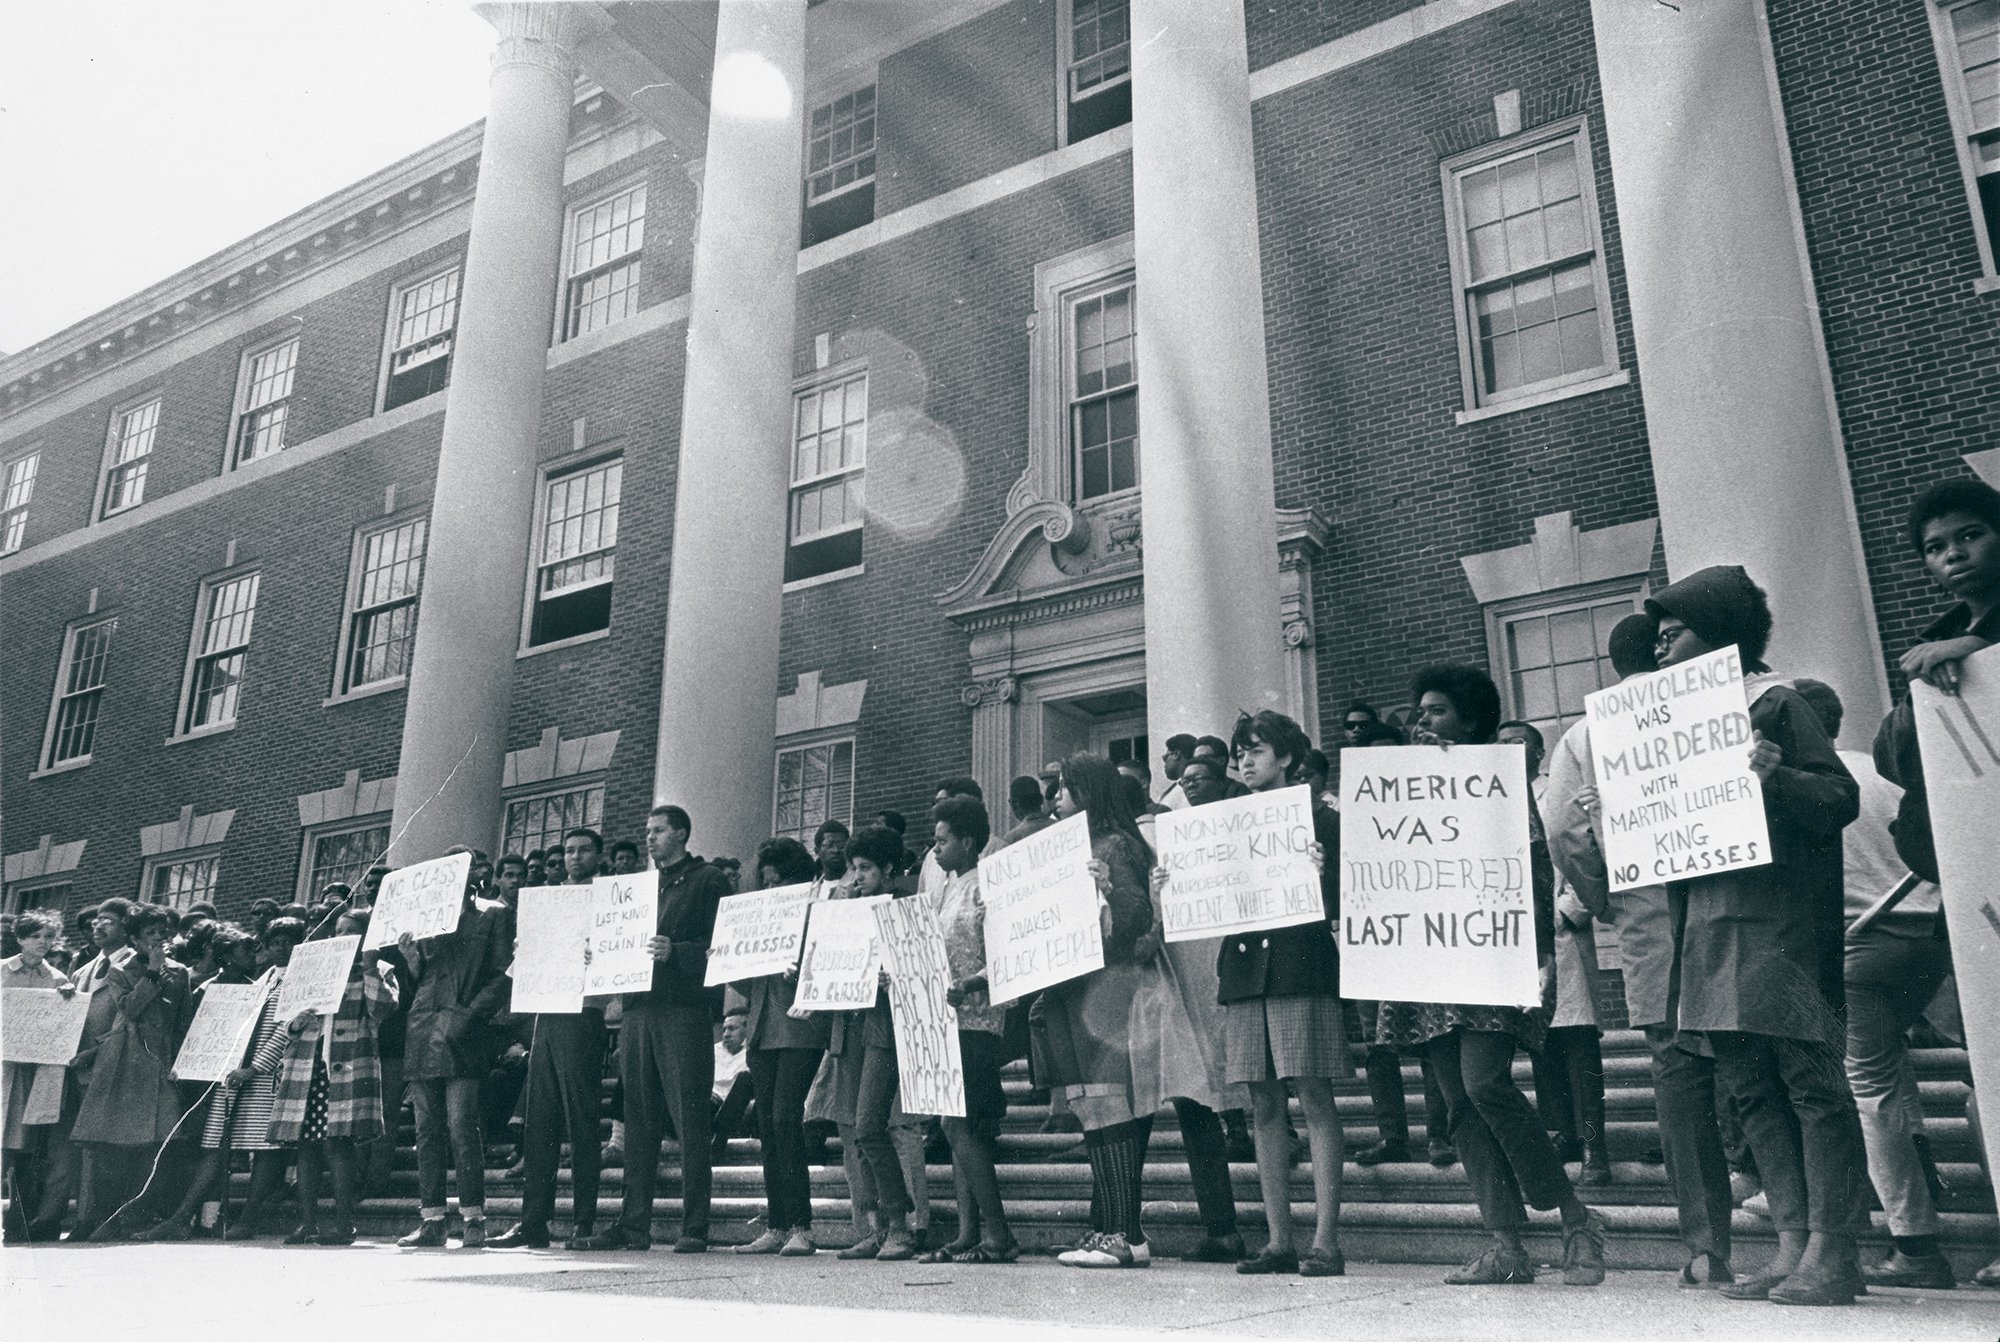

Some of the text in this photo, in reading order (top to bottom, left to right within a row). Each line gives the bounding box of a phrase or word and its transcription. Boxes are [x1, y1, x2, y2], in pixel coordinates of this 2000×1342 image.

[1593, 654, 1742, 722] NONVIOLENCE
[1635, 704, 1672, 731] WAS
[1602, 711, 1751, 781] MURDERED
[1354, 773, 1508, 803] AMERICA
[1641, 772, 1678, 797] WITH
[1172, 803, 1303, 845] NON-VIOLENT
[1609, 776, 1755, 836] MARTIN LUTHER
[1162, 825, 1311, 872] BROTHER KING
[1372, 815, 1461, 846] WAS
[1654, 822, 1710, 857] KING
[984, 822, 1087, 892] KING MURDERED
[1614, 841, 1758, 886] NO CLASSES
[385, 859, 460, 901] NO CLASS
[610, 881, 634, 906] OUR
[1171, 862, 1292, 897] MURDERED BY
[378, 915, 398, 946] IS
[416, 904, 456, 938] DEAD
[595, 904, 650, 928] LAST KING
[871, 901, 900, 944] THE
[1008, 903, 1062, 943] AWAKEN
[1164, 880, 1322, 931] VIOLENT WHITE MEN
[597, 935, 636, 954] SLAIN
[615, 926, 624, 936] IS
[715, 943, 730, 957] NO
[734, 933, 798, 957] CLASSES
[732, 921, 784, 940] MURDER
[1346, 909, 1528, 948] LAST NIGHT
[812, 948, 867, 972] MURDER
[992, 922, 1101, 988] BLACK PEOPLE
[591, 976, 605, 989] NO
[825, 980, 873, 1003] CLASSES
[891, 975, 923, 1025] ARE
[902, 1022, 951, 1071] READY
[901, 1068, 963, 1116] NIGGER?
